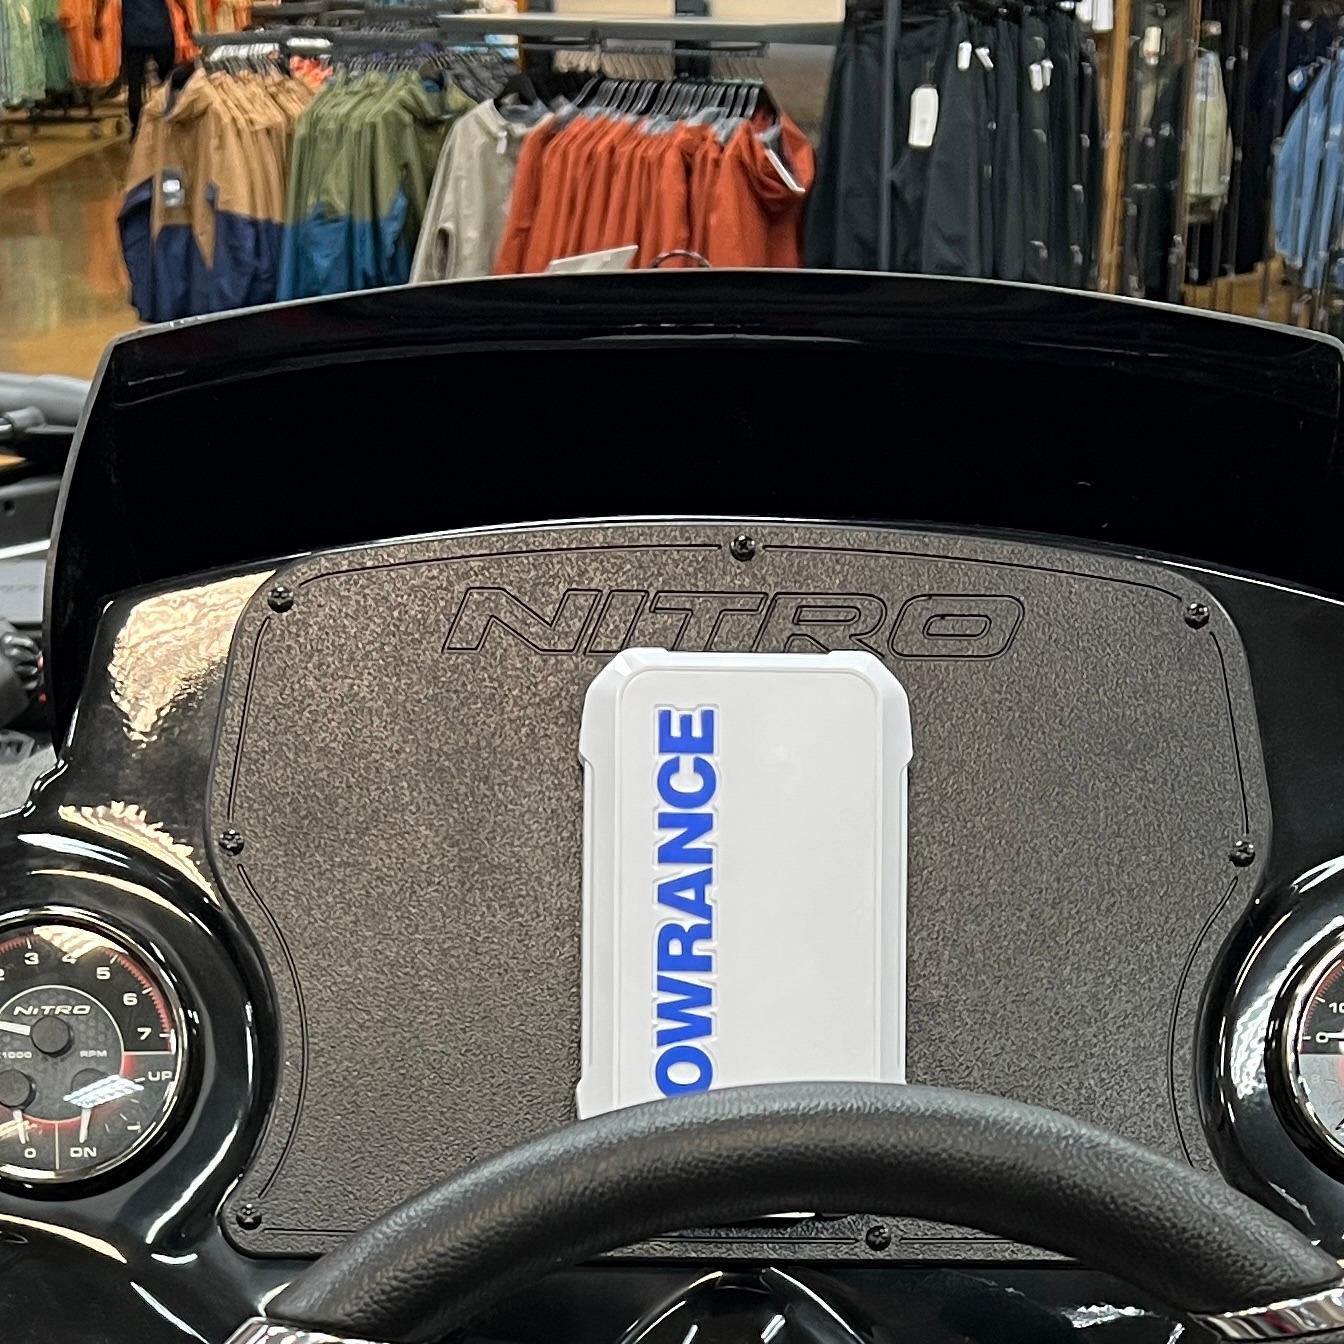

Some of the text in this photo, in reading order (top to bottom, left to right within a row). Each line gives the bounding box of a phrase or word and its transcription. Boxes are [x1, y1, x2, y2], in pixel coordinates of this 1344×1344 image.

[442, 586, 1026, 662] NITRO
[656, 706, 717, 1095] OWRANCE
[24, 953, 40, 966] 3
[62, 954, 77, 965] 4
[96, 967, 110, 980] 5
[122, 993, 138, 1005] 6
[14, 1005, 92, 1016] NITRO
[136, 1028, 152, 1041] 7
[1315, 1033, 1329, 1043] 0
[80, 1050, 107, 1058] RPM
[147, 1071, 173, 1082] UP
[24, 1149, 37, 1158] 0
[70, 1147, 97, 1158] DN
